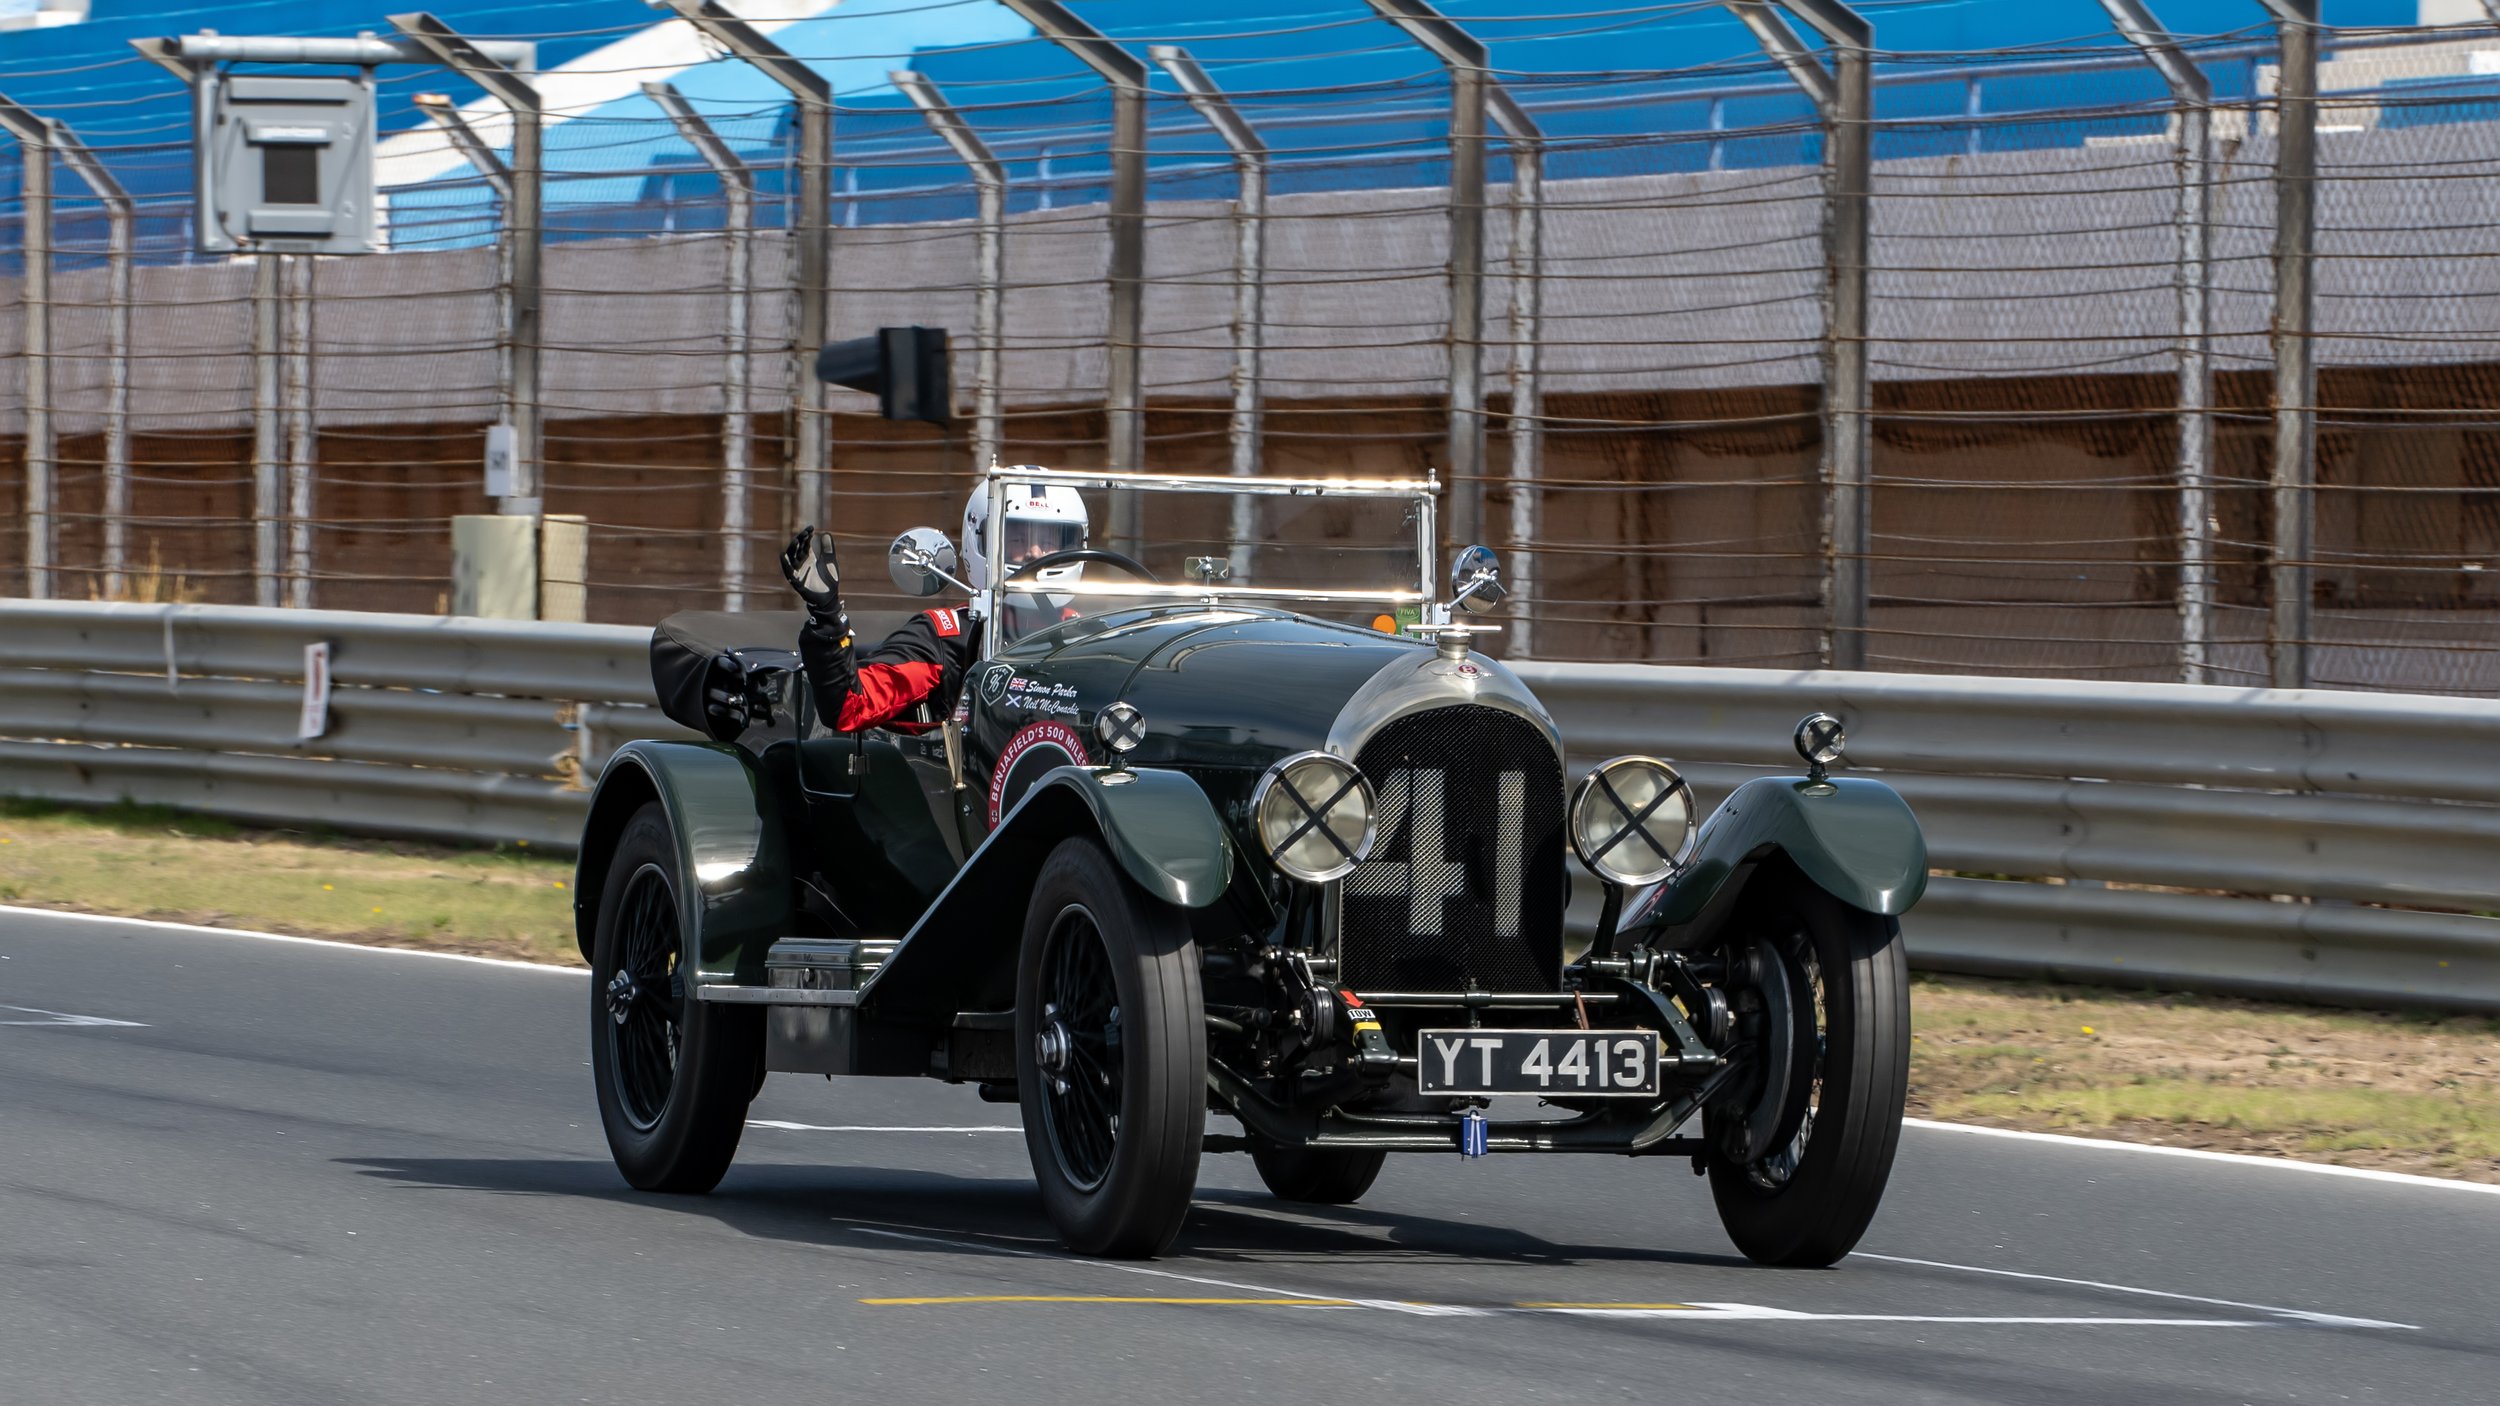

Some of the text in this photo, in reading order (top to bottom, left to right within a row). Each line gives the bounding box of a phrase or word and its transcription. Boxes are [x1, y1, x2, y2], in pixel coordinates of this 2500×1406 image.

[1023, 696, 1038, 710] Neil
[1025, 680, 1078, 698] Simon Parker
[991, 726, 1087, 802] BENJAFIELD'S 500 MILES
[1342, 768, 1526, 937] 41
[1349, 1010, 1373, 1018] TOW
[1433, 1038, 1646, 1088] YT 4413
